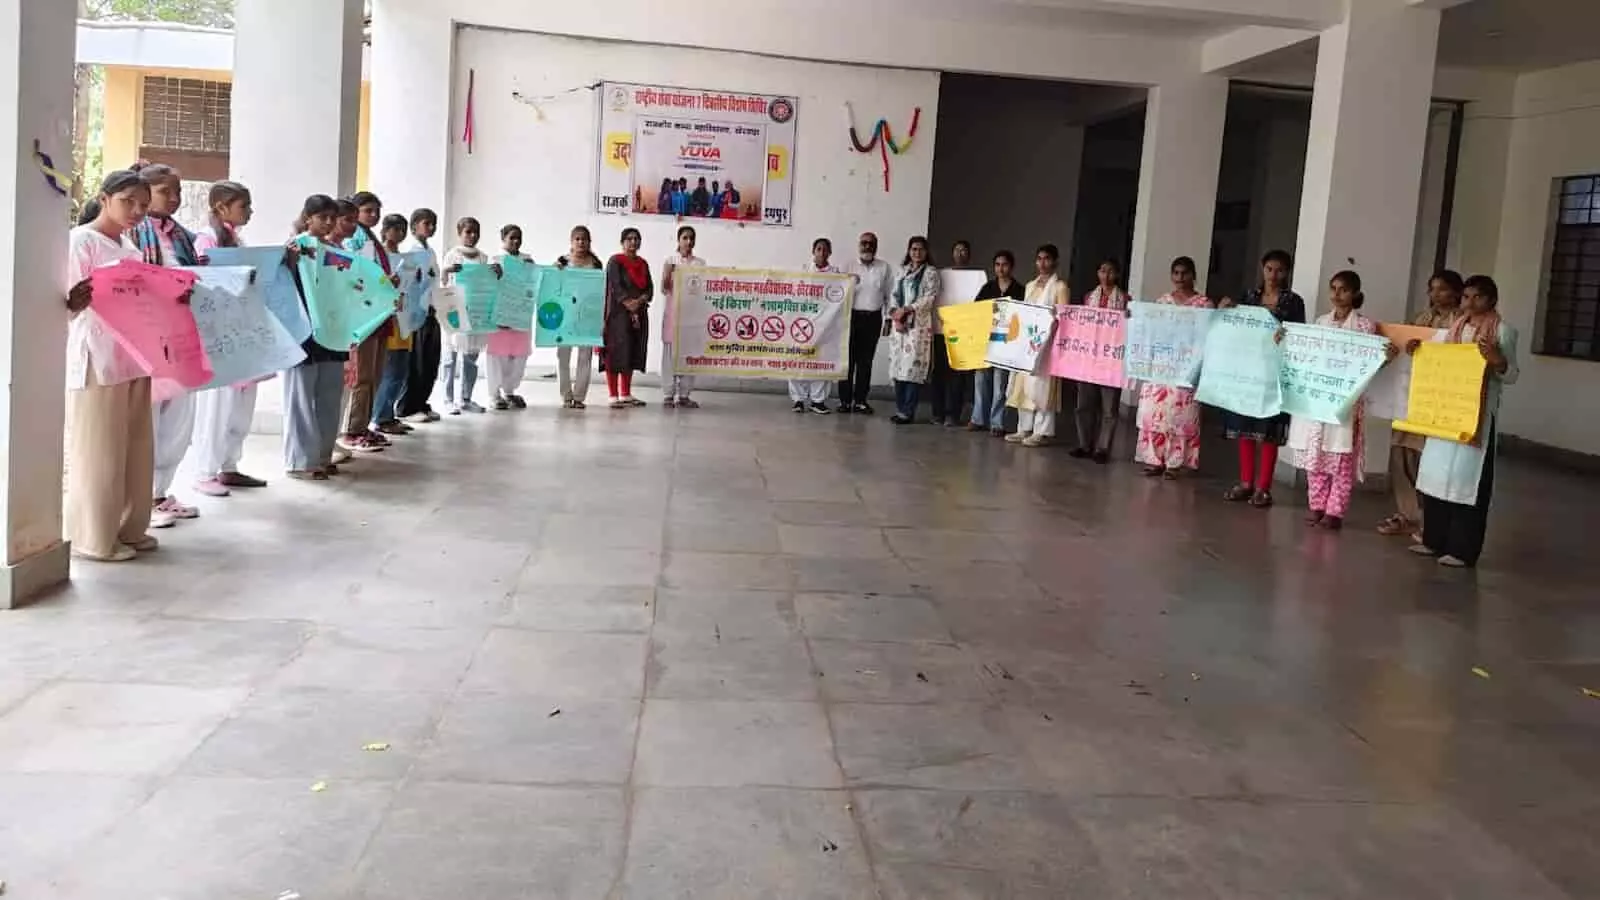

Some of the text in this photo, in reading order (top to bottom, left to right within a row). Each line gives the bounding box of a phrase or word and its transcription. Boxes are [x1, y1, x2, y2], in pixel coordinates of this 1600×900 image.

[680, 145, 720, 158] YUVA
[706, 276, 733, 292] राजकीय
[734, 280, 752, 292] कन्या
